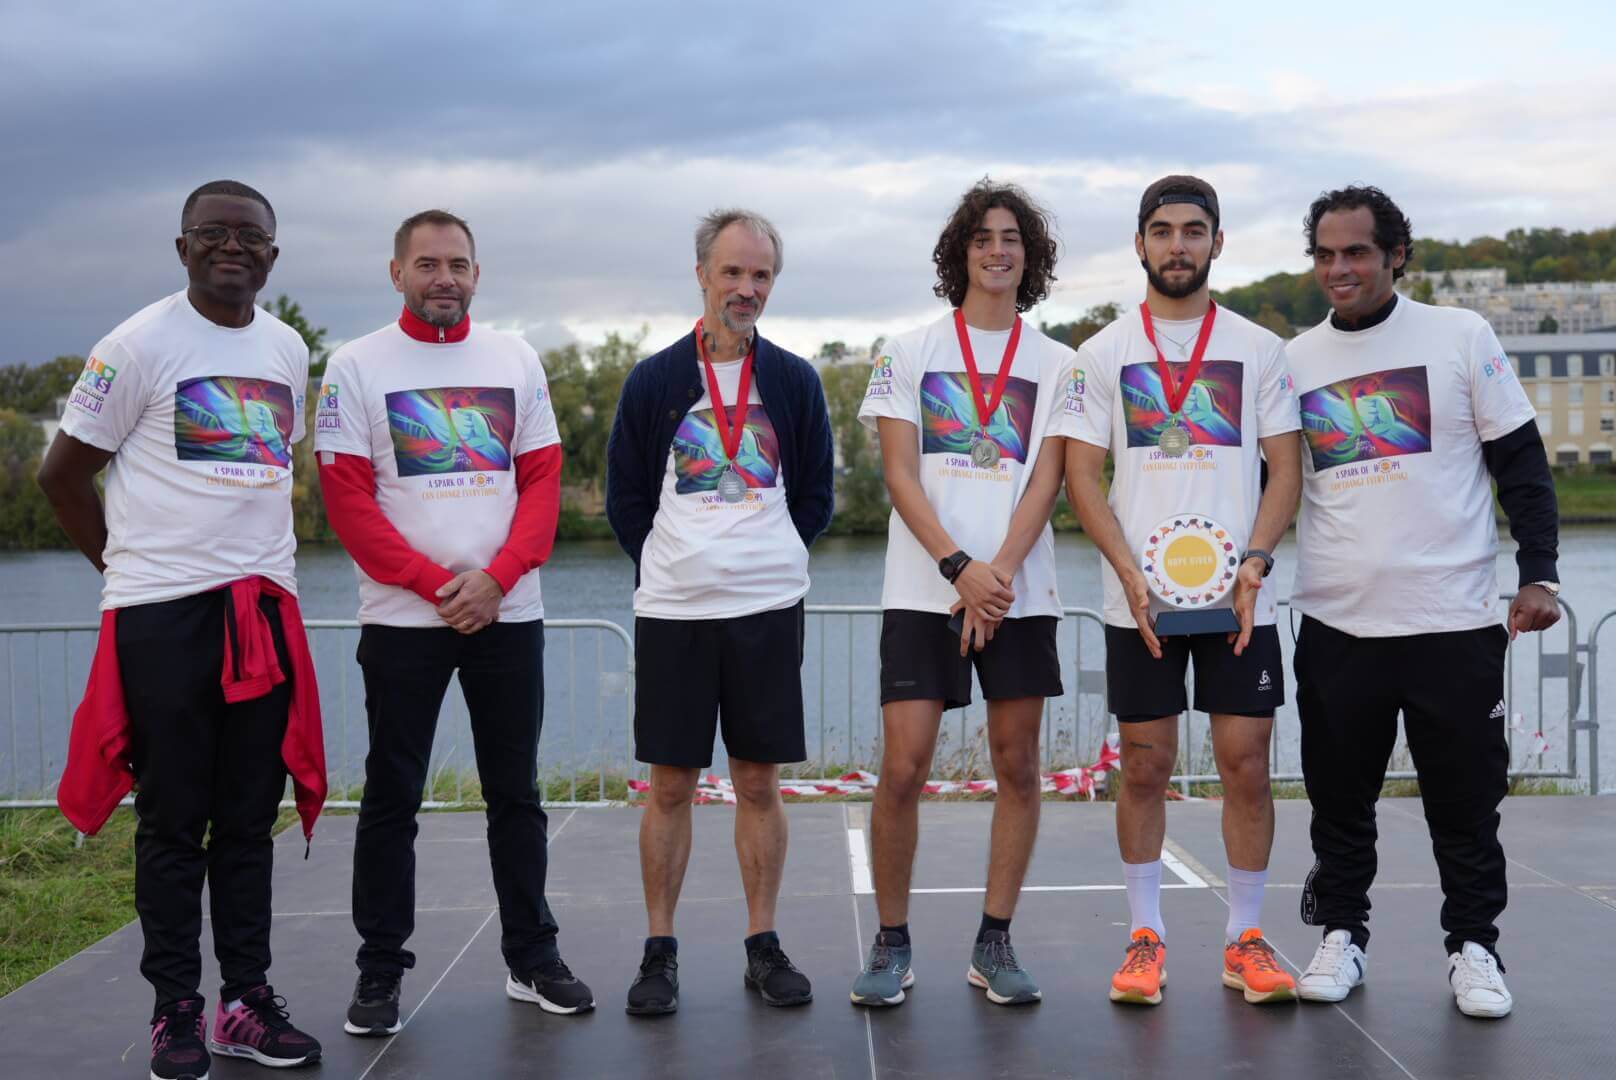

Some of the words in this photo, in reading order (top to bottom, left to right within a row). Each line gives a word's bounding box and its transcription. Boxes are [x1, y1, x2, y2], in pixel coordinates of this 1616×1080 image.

[950, 457, 969, 468] SPARK
[220, 467, 245, 477] SPARK
[1341, 467, 1360, 479] SPARK
[434, 478, 456, 489] SPARK
